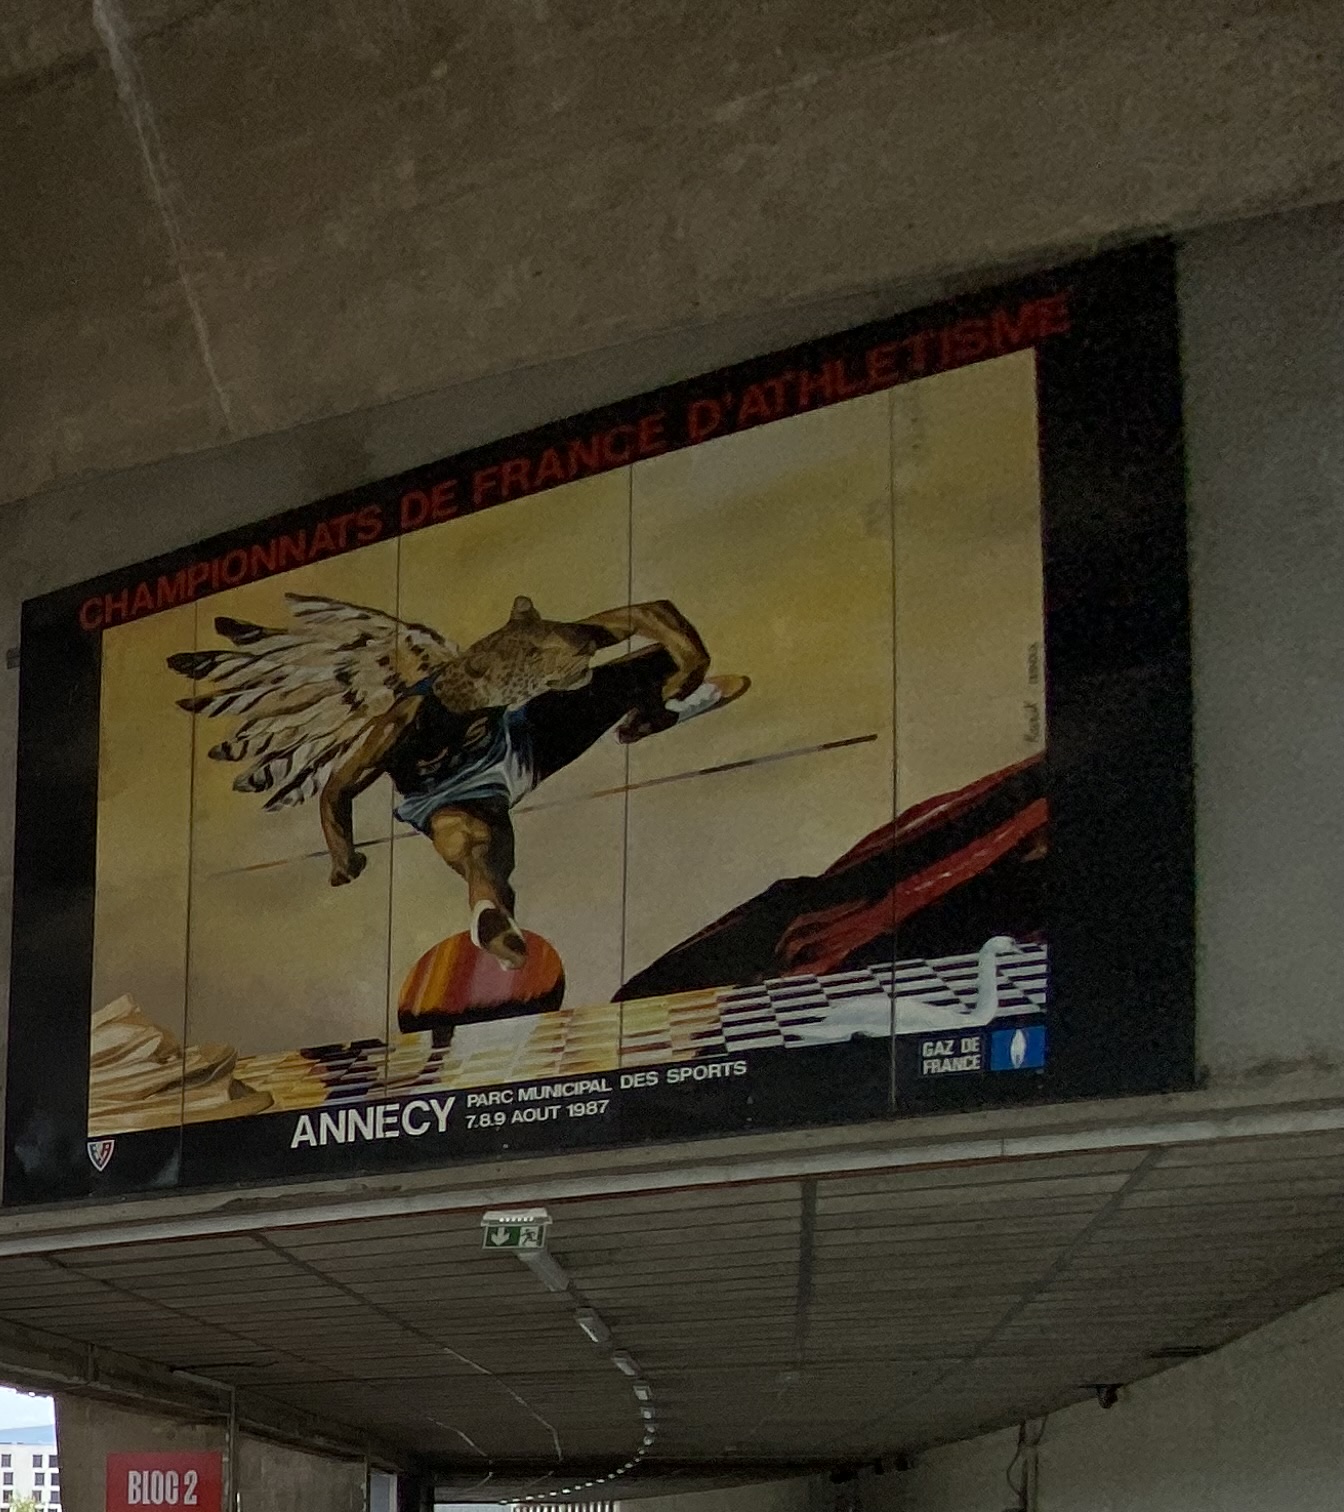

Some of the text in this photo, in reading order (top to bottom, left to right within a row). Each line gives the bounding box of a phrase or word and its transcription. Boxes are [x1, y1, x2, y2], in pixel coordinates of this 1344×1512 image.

[78, 505, 383, 631] CHAMPIONNATS
[400, 480, 461, 529] DE
[472, 414, 668, 506] FRANCE
[922, 1036, 981, 1057] GAZ DE
[923, 1054, 981, 1075] FRANCE
[467, 1060, 748, 1108] PARC MUNICIPAL DES SPORTS
[290, 1096, 457, 1149] ANNECY
[511, 1105, 562, 1125] AOUT
[566, 1099, 610, 1118] 1987
[127, 1469, 198, 1505] BLOC 2
